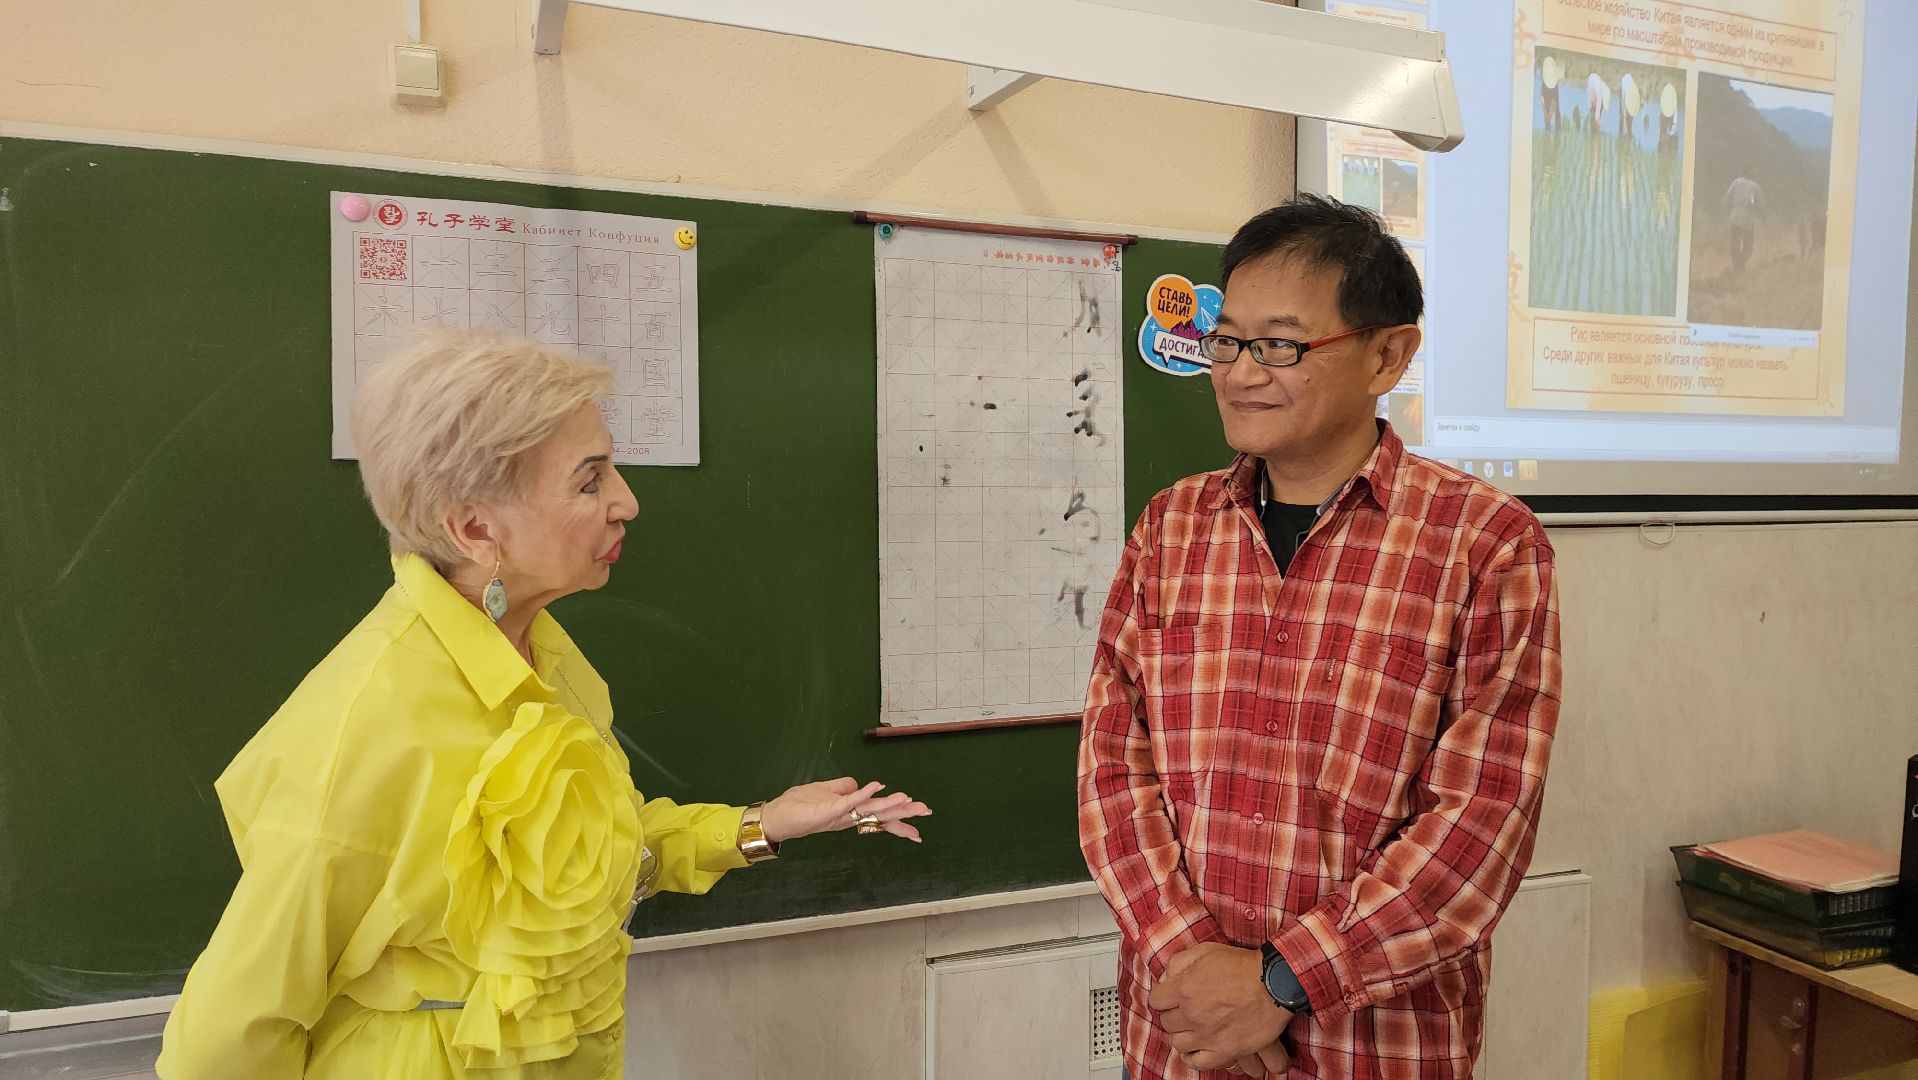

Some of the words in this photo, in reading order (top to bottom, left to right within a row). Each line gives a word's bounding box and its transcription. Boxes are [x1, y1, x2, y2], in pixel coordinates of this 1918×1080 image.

[1604, 2, 1651, 20] хозяйство
[1655, 8, 1681, 25] Китая
[1684, 18, 1725, 33] является
[1726, 24, 1753, 39] одним
[1755, 29, 1765, 41] из
[1766, 32, 1817, 50] крупнейших
[1819, 41, 1825, 51] в
[1588, 21, 1611, 37] мире
[1613, 26, 1625, 38] по
[1627, 29, 1681, 46] масштабам
[1684, 37, 1746, 57] производимой
[417, 211, 516, 234] 孔子学堂
[522, 223, 581, 236] Кабинет
[588, 228, 659, 244] Конфуция
[476, 253, 517, 276] 二
[531, 257, 570, 283] 三
[586, 262, 620, 289] 四
[637, 264, 672, 292] 五
[1159, 286, 1192, 305] СТАВЬ
[1157, 299, 1190, 318] ЦЕЛИ!
[533, 301, 571, 335] 九
[583, 304, 621, 342] 十
[639, 312, 672, 342] 百
[1570, 326, 1588, 342] Рис
[1590, 330, 1632, 343] является
[1635, 331, 1676, 345] основной
[1543, 345, 1573, 362] Среди
[1575, 350, 1604, 365] других
[1608, 351, 1642, 364] важных
[1644, 353, 1662, 366] для
[1664, 352, 1689, 366] Китая
[1692, 356, 1725, 370] культур
[1727, 358, 1753, 368] можно
[1756, 359, 1789, 371] назвать
[1656, 374, 1694, 389] кукурузу,
